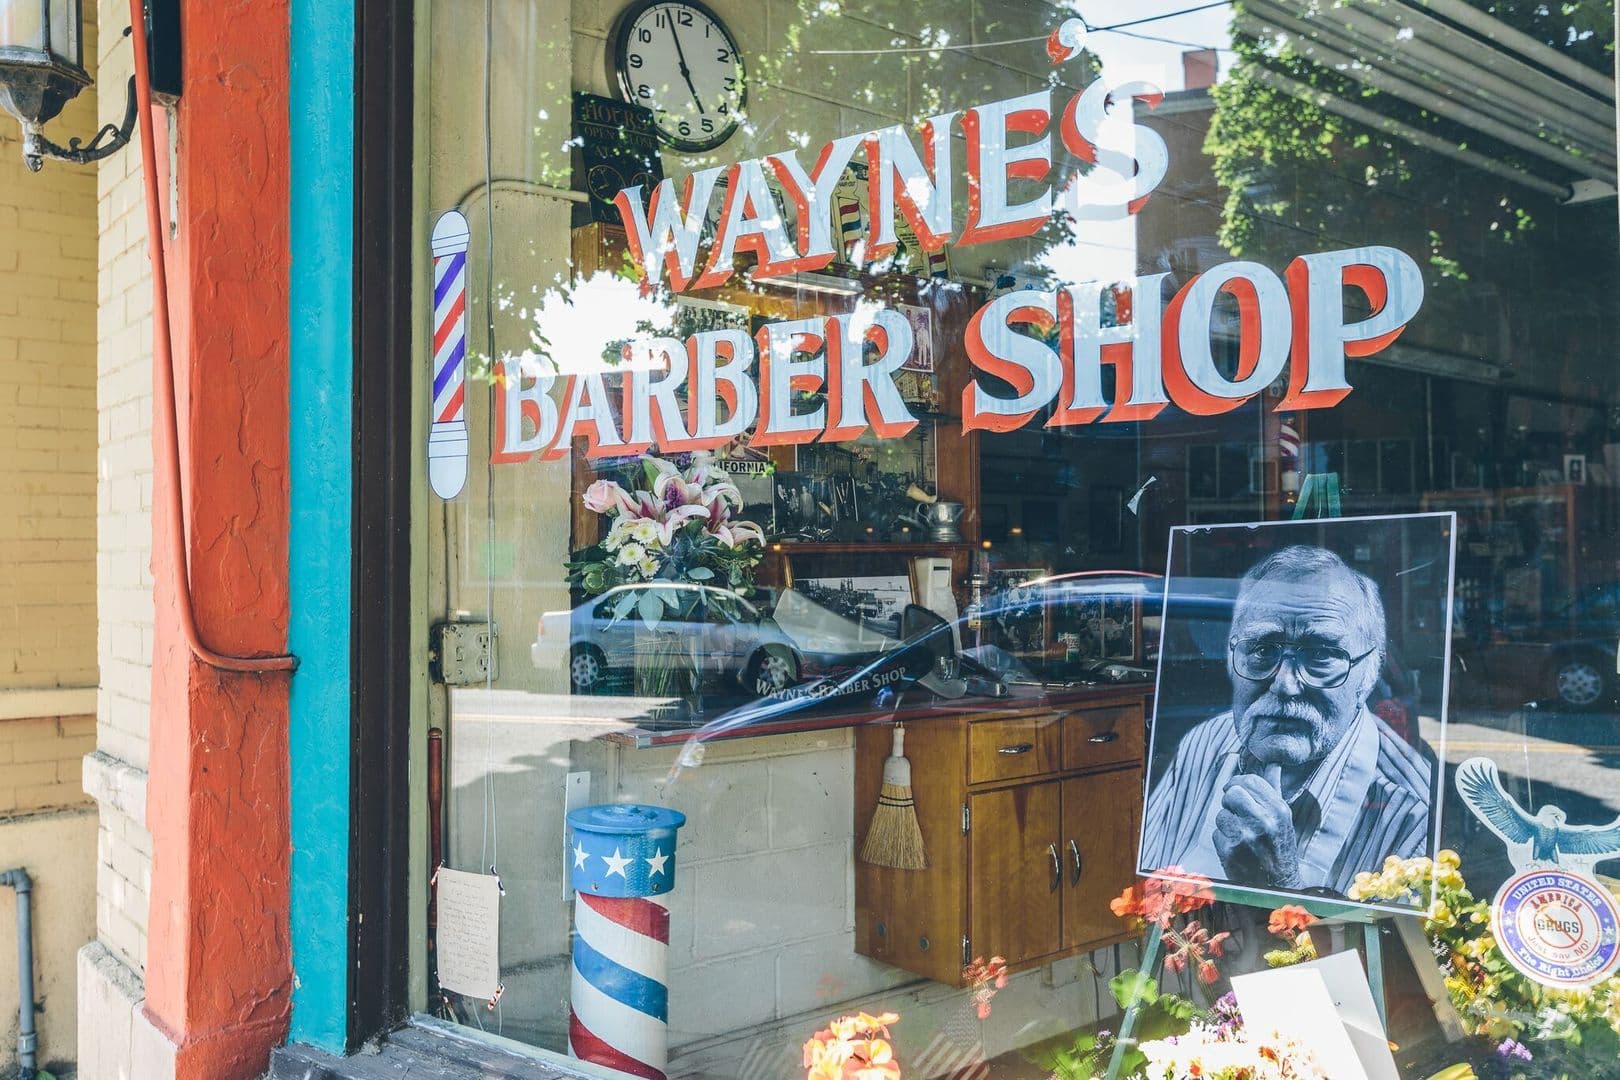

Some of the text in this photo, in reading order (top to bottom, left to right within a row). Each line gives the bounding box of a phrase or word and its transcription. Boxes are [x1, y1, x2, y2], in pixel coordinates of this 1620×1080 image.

[656, 13, 665, 29] 11
[678, 10, 693, 27] 12
[639, 28, 652, 43] 10
[629, 54, 643, 68] 9
[717, 49, 729, 63] 2
[638, 84, 652, 99] 8
[723, 77, 736, 91] 3
[717, 102, 728, 116] 4
[678, 121, 691, 136] 6
[701, 119, 714, 133] 5
[613, 17, 1169, 293] WAYNE'S
[490, 245, 1425, 465] BARBER SHOP
[713, 460, 766, 473] IFORNIA
[1512, 876, 1602, 907] UNITED STATES
